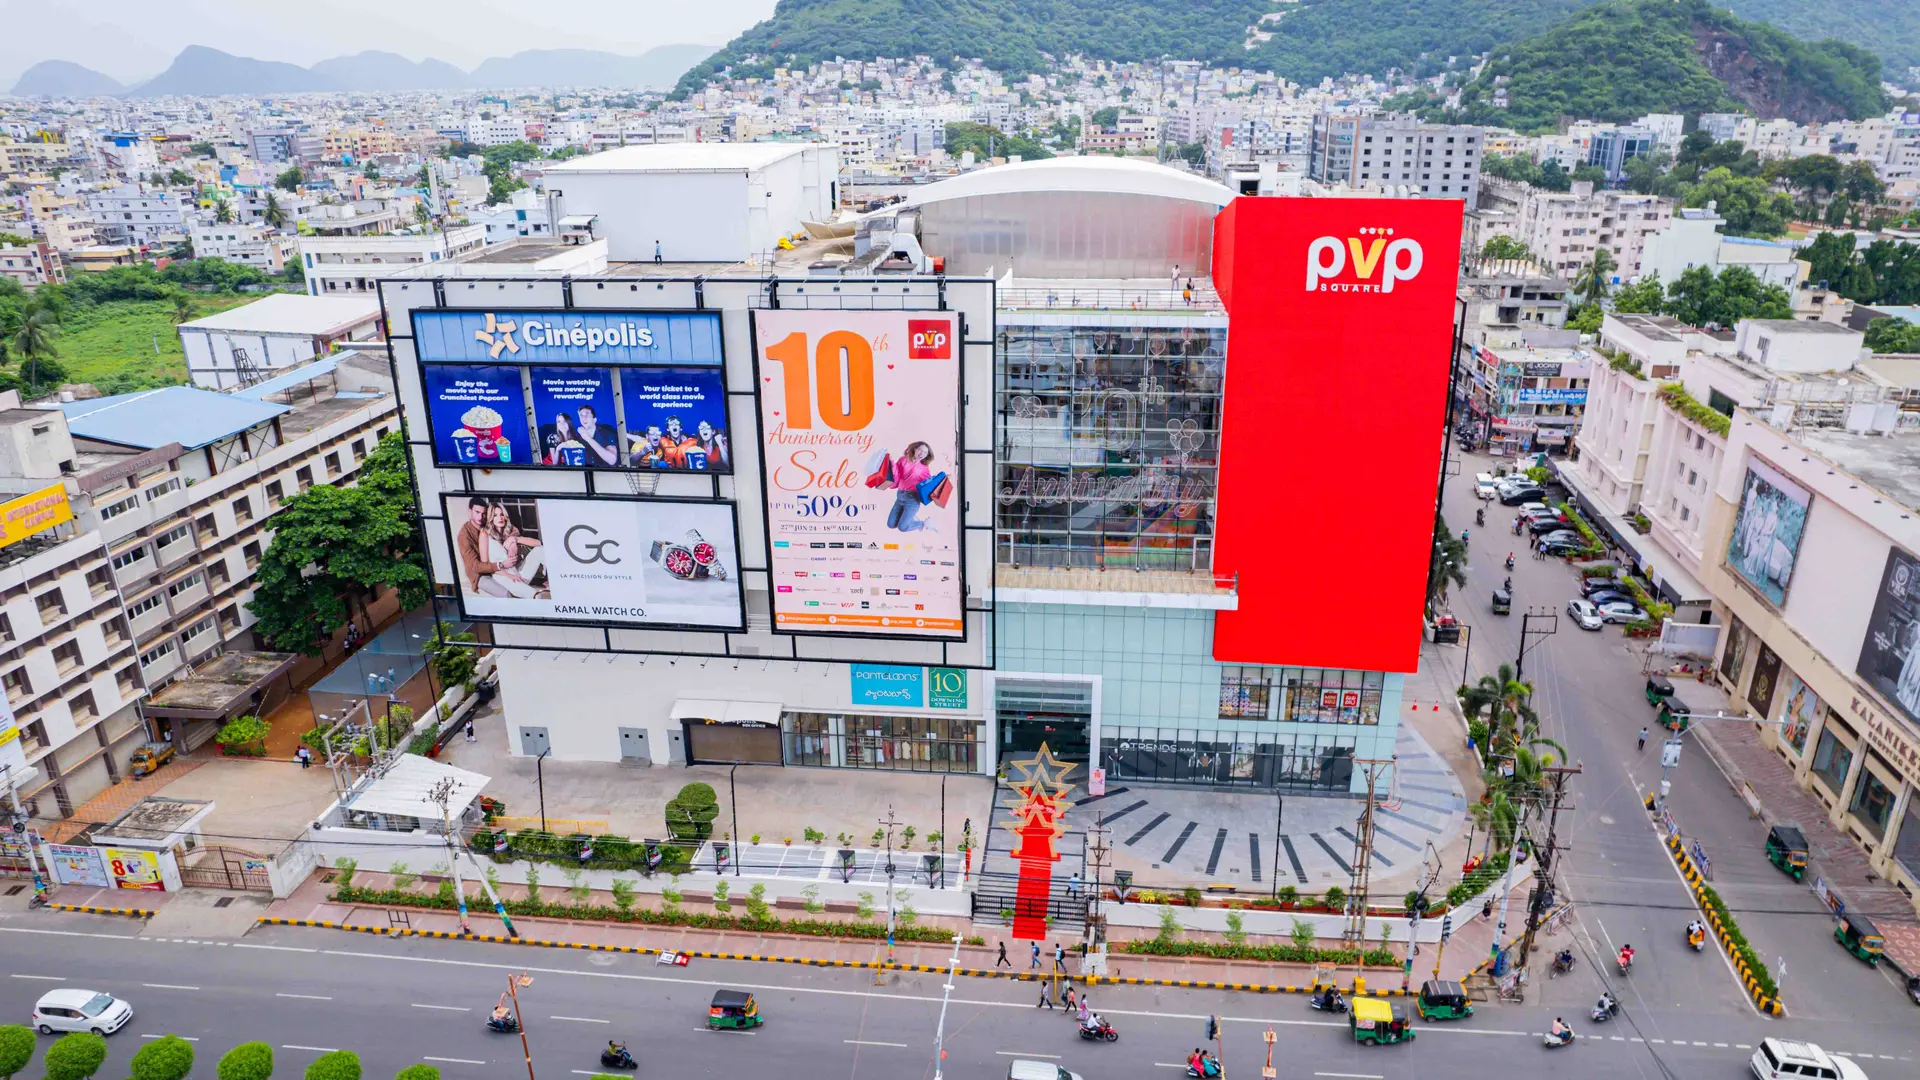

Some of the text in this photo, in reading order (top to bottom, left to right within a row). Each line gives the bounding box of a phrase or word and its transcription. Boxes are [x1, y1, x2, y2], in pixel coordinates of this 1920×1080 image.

[1305, 235, 1424, 294] pvp
[1320, 283, 1380, 293] SQUARE
[522, 320, 653, 352] Cinépolis
[913, 332, 946, 349] pvp
[566, 379, 600, 387] watching
[652, 401, 693, 409] experience
[767, 421, 876, 453] Anniversary
[773, 449, 859, 492] Sale
[796, 495, 859, 517] 50%
[563, 524, 622, 565] Gc
[554, 605, 648, 617] KAMAL WATCH CO.
[934, 672, 962, 693] 10
[1851, 696, 1920, 771] KALANIKE
[1130, 742, 1178, 753] TRENDS
[1867, 731, 1903, 767] SHOPPING
